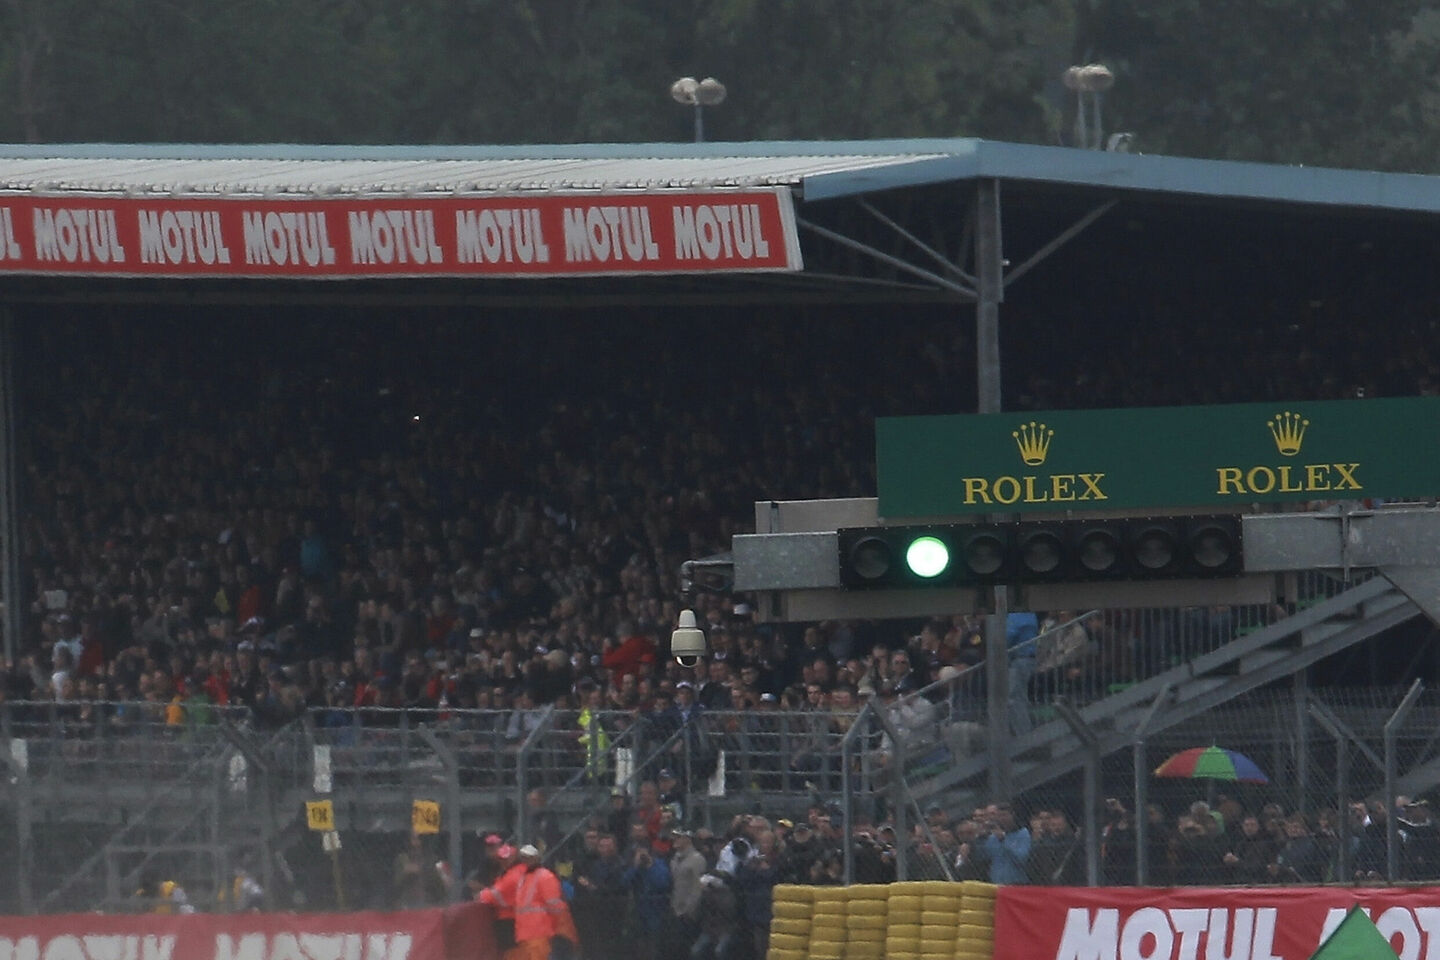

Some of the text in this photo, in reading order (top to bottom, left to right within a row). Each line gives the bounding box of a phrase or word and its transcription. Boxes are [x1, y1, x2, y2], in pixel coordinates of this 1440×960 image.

[33, 207, 125, 263] MOTUL
[138, 208, 231, 265] MOTUL
[243, 210, 335, 267] MOTUL
[348, 208, 443, 265] MOTUL
[456, 207, 549, 264] MOTUL
[563, 205, 659, 262] MOTUL
[672, 203, 769, 260] MOTUL
[962, 463, 1363, 505] ROLEX ROLEX
